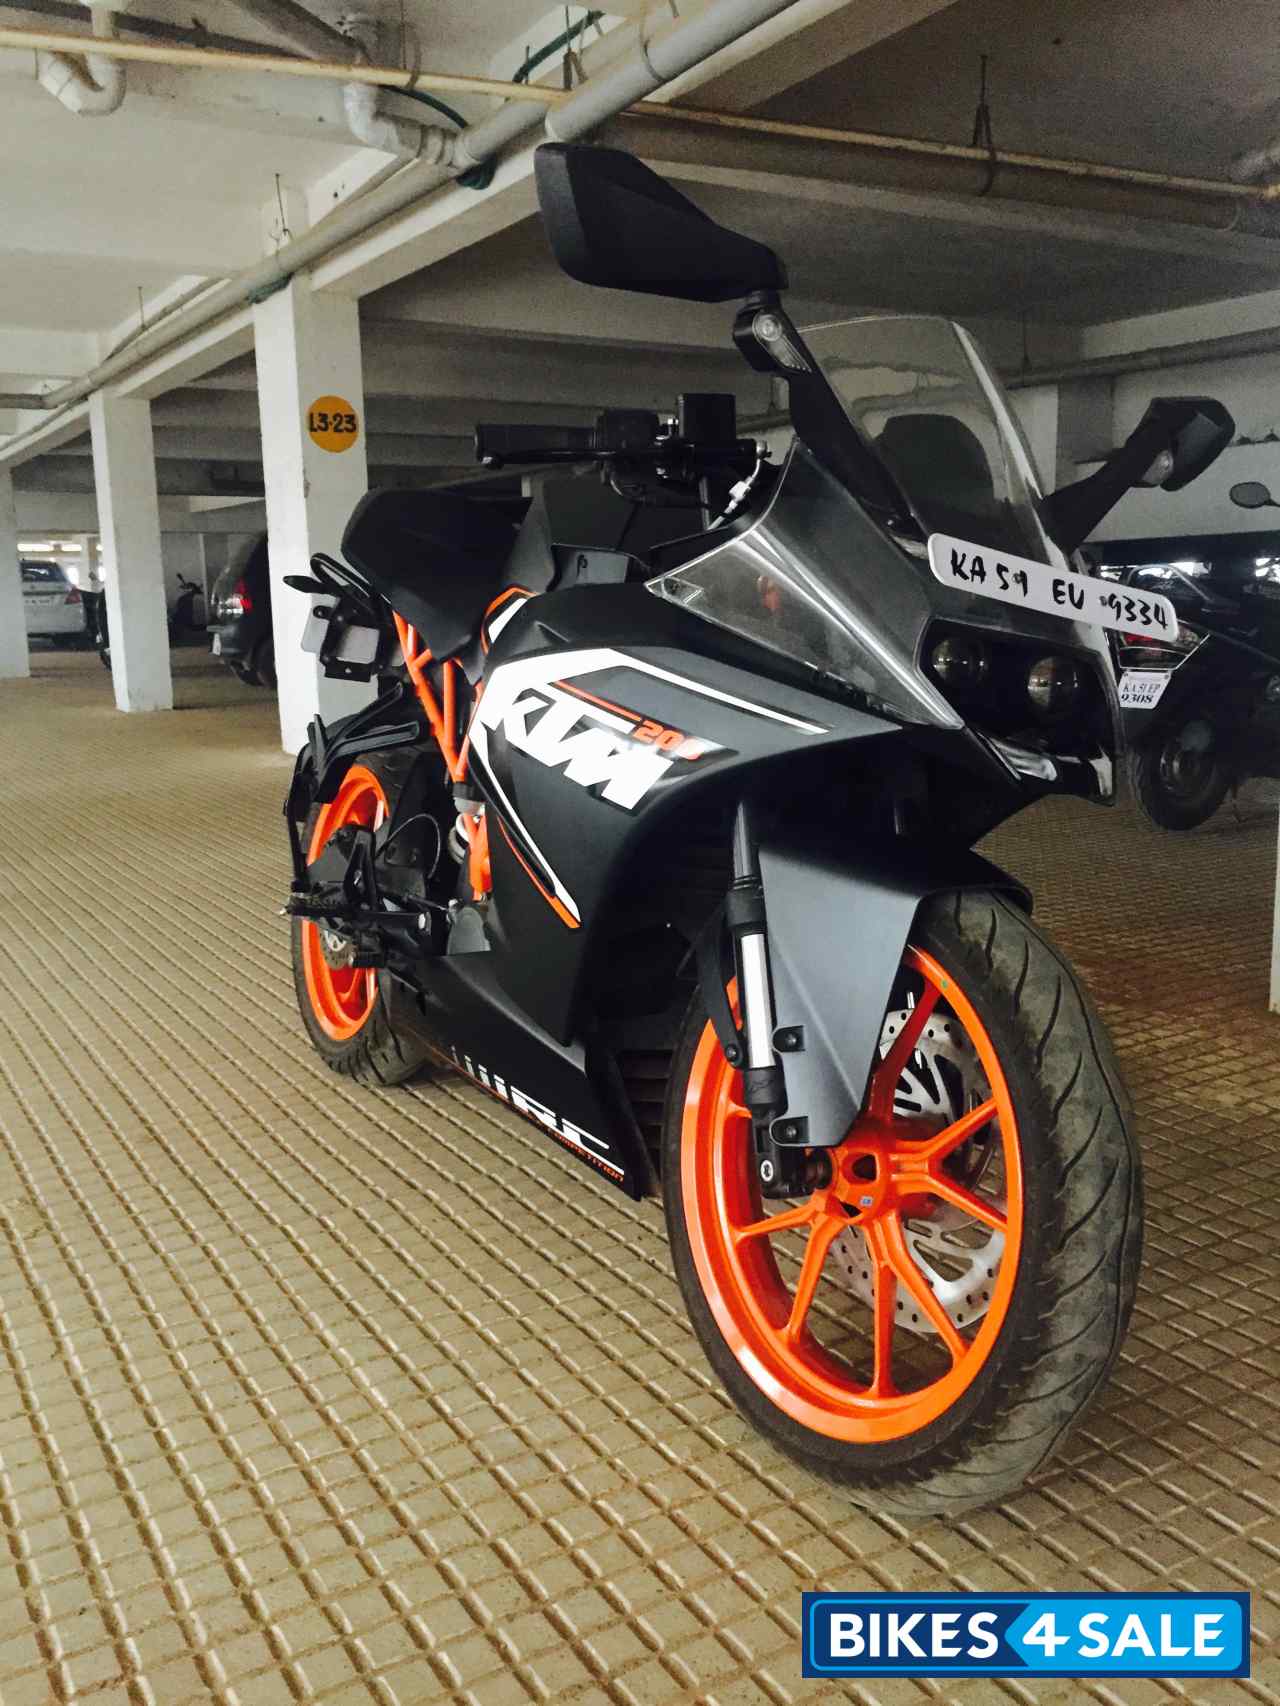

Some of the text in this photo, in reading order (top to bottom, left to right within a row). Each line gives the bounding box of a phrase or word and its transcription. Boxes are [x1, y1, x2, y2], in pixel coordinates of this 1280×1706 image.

[951, 548, 986, 584] KA
[1052, 579, 1084, 610] EU
[1108, 593, 1168, 630] 9334
[480, 684, 674, 810] KTM
